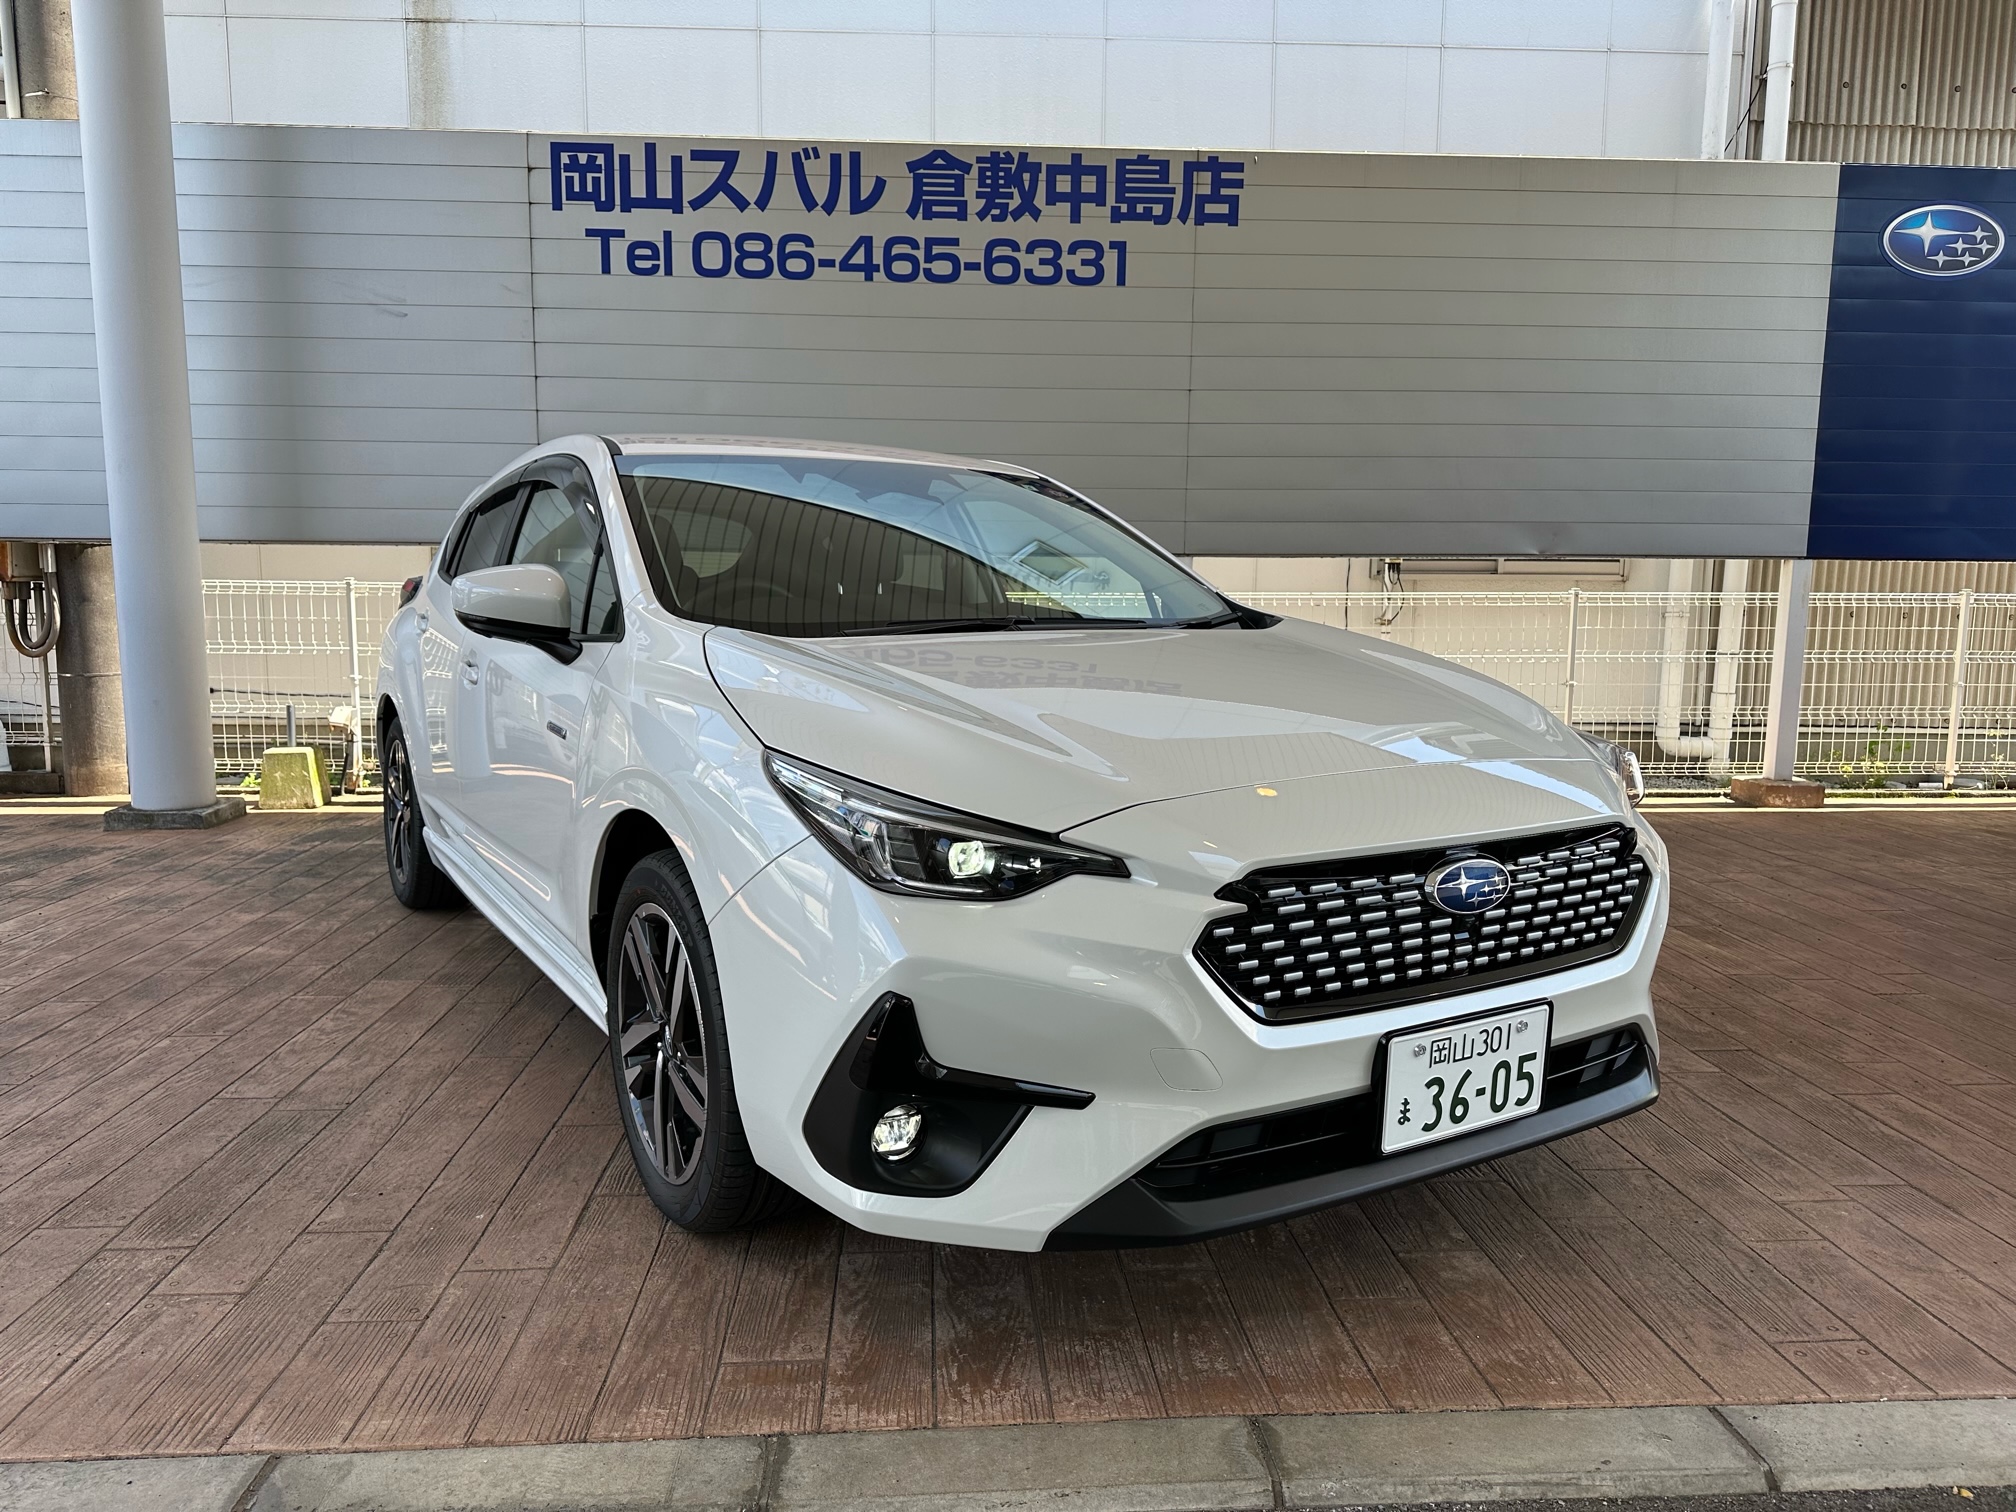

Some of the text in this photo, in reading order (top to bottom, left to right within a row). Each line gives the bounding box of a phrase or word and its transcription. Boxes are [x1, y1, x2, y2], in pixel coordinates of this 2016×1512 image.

[551, 142, 1245, 227] 岡山スバル 倉敷中島店
[585, 228, 1127, 287] Tel 086-465-6331
[1397, 1052, 1538, 1133] ま 36-05
